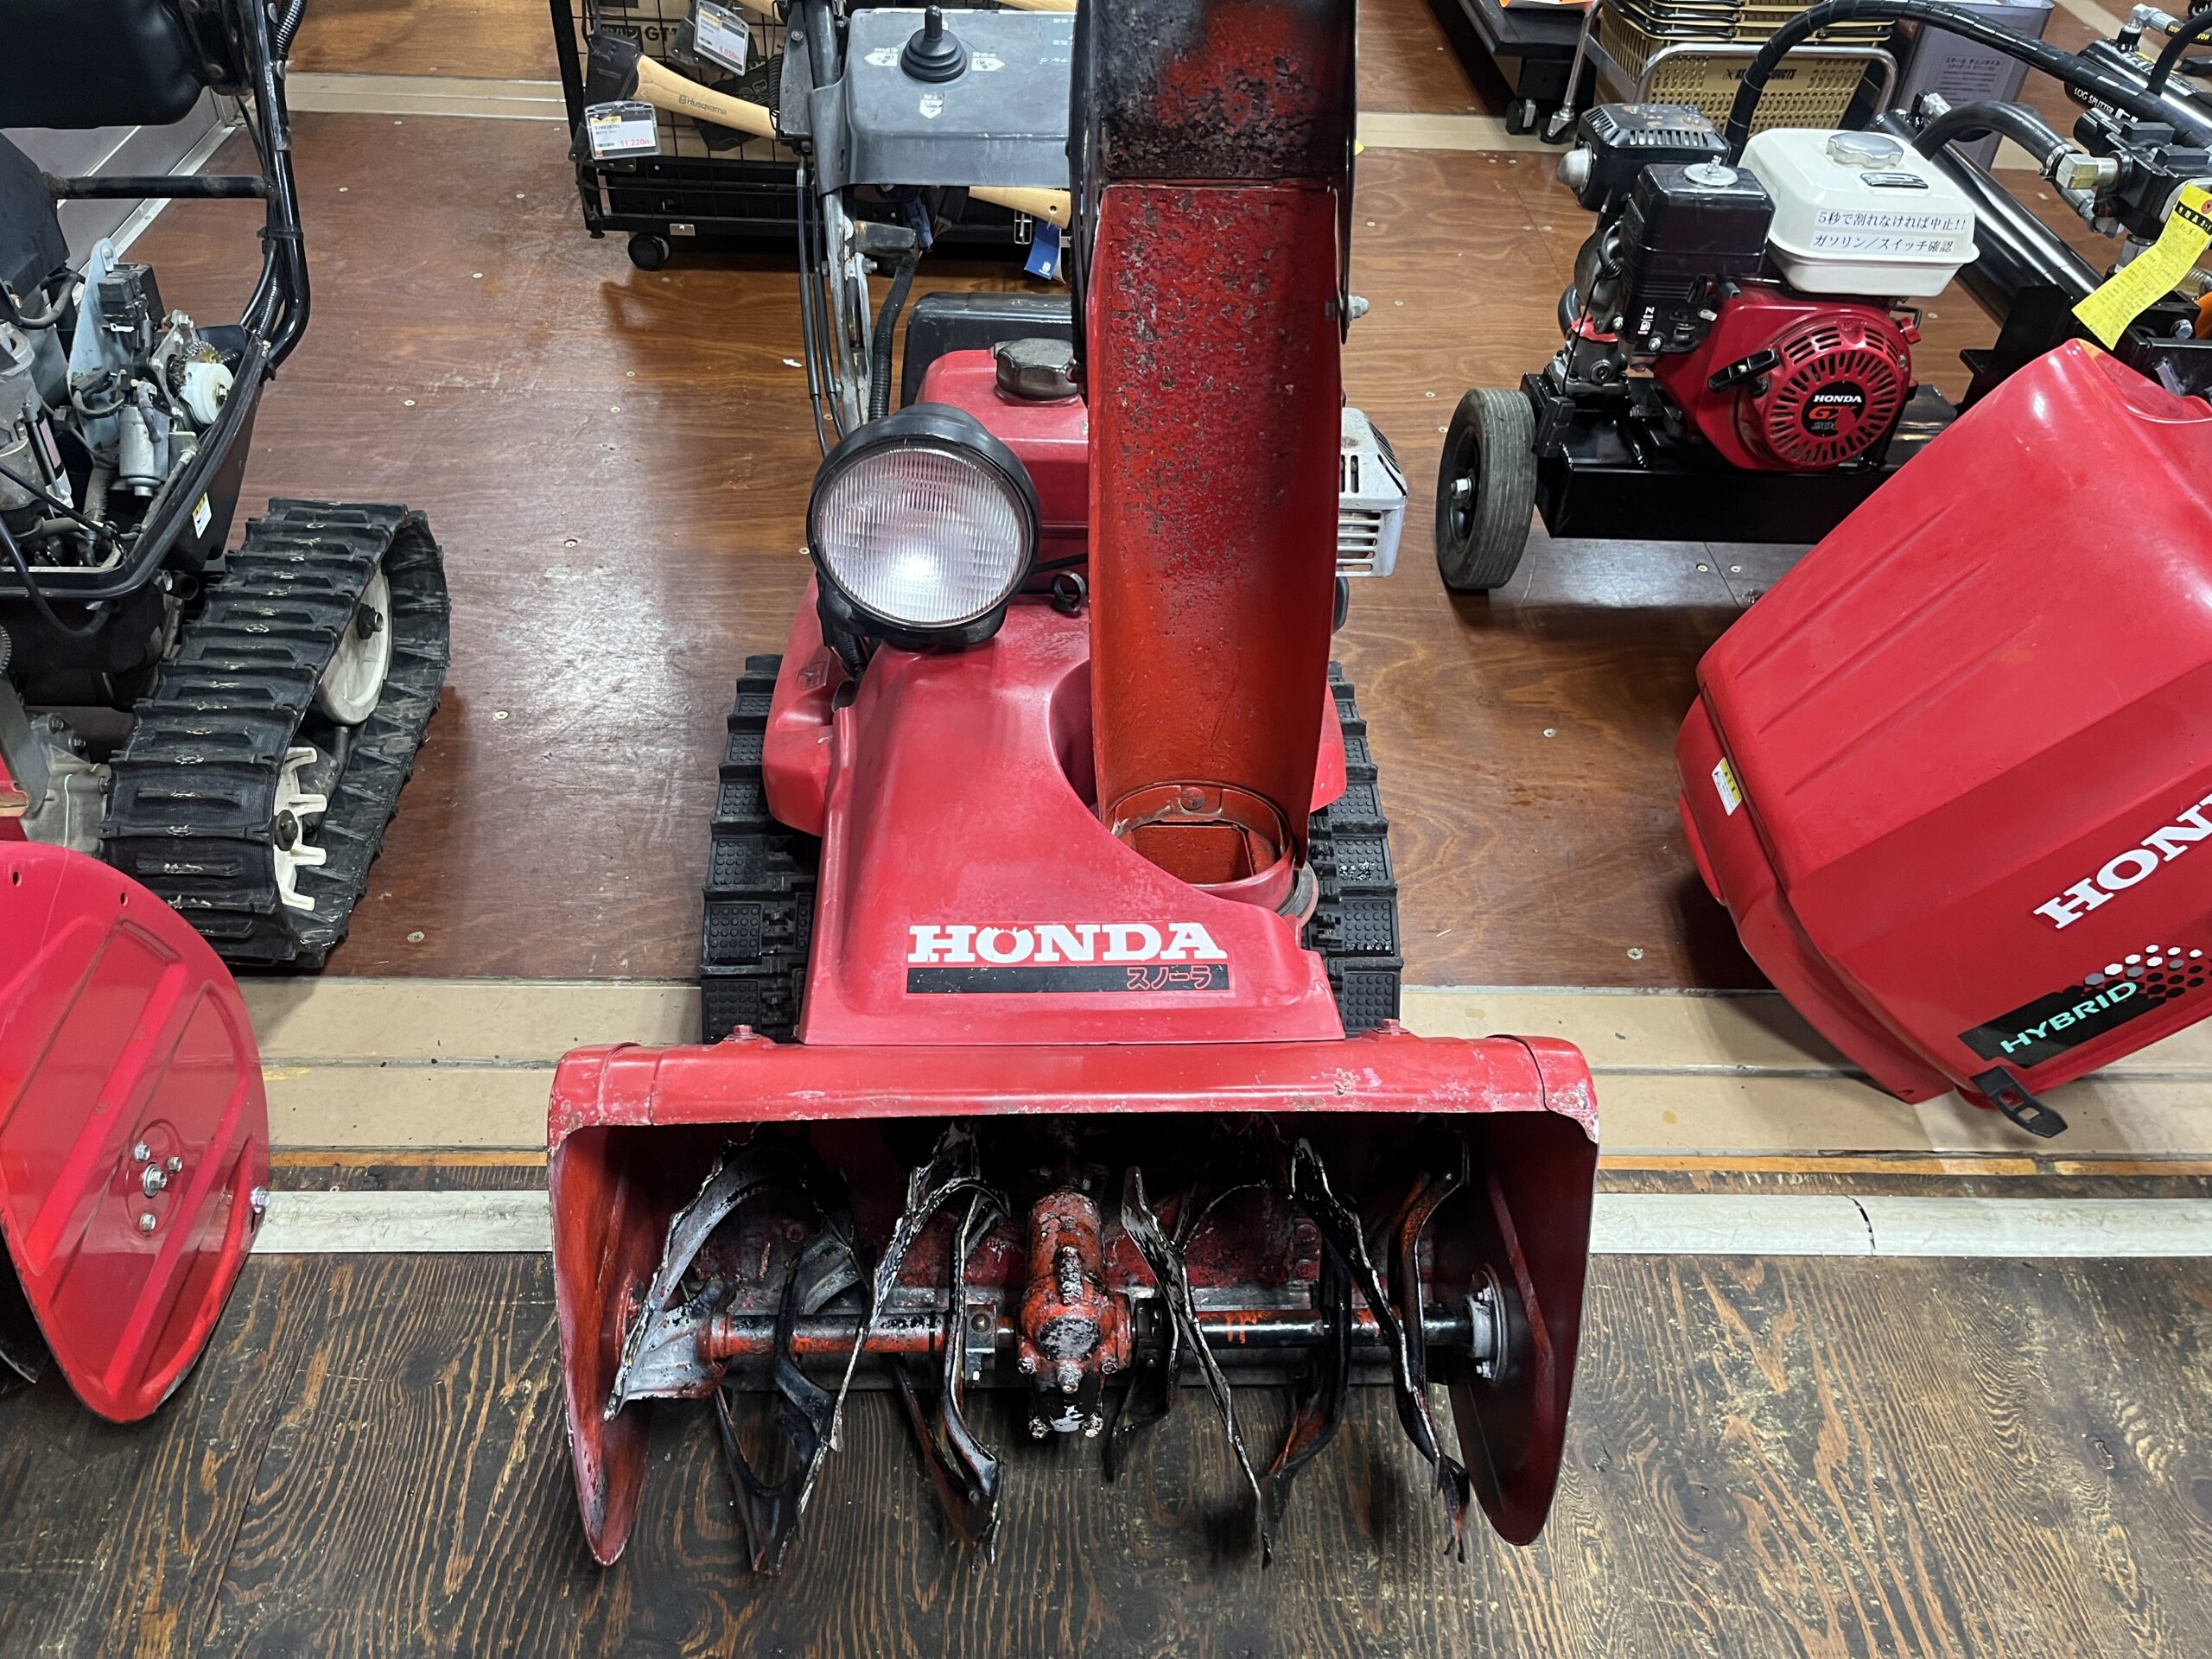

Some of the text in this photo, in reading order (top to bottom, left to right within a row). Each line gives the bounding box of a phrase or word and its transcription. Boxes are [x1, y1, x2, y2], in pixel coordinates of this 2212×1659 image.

[687, 98, 727, 115] Husqvarna
[2074, 87, 2088, 101] LOG
[2088, 95, 2114, 117] SPLITTER
[2033, 793, 2212, 930] HON
[907, 922, 1227, 963] HONDA
[1126, 966, 1211, 990] スノーラ
[1999, 982, 2137, 1053] HYBRID
